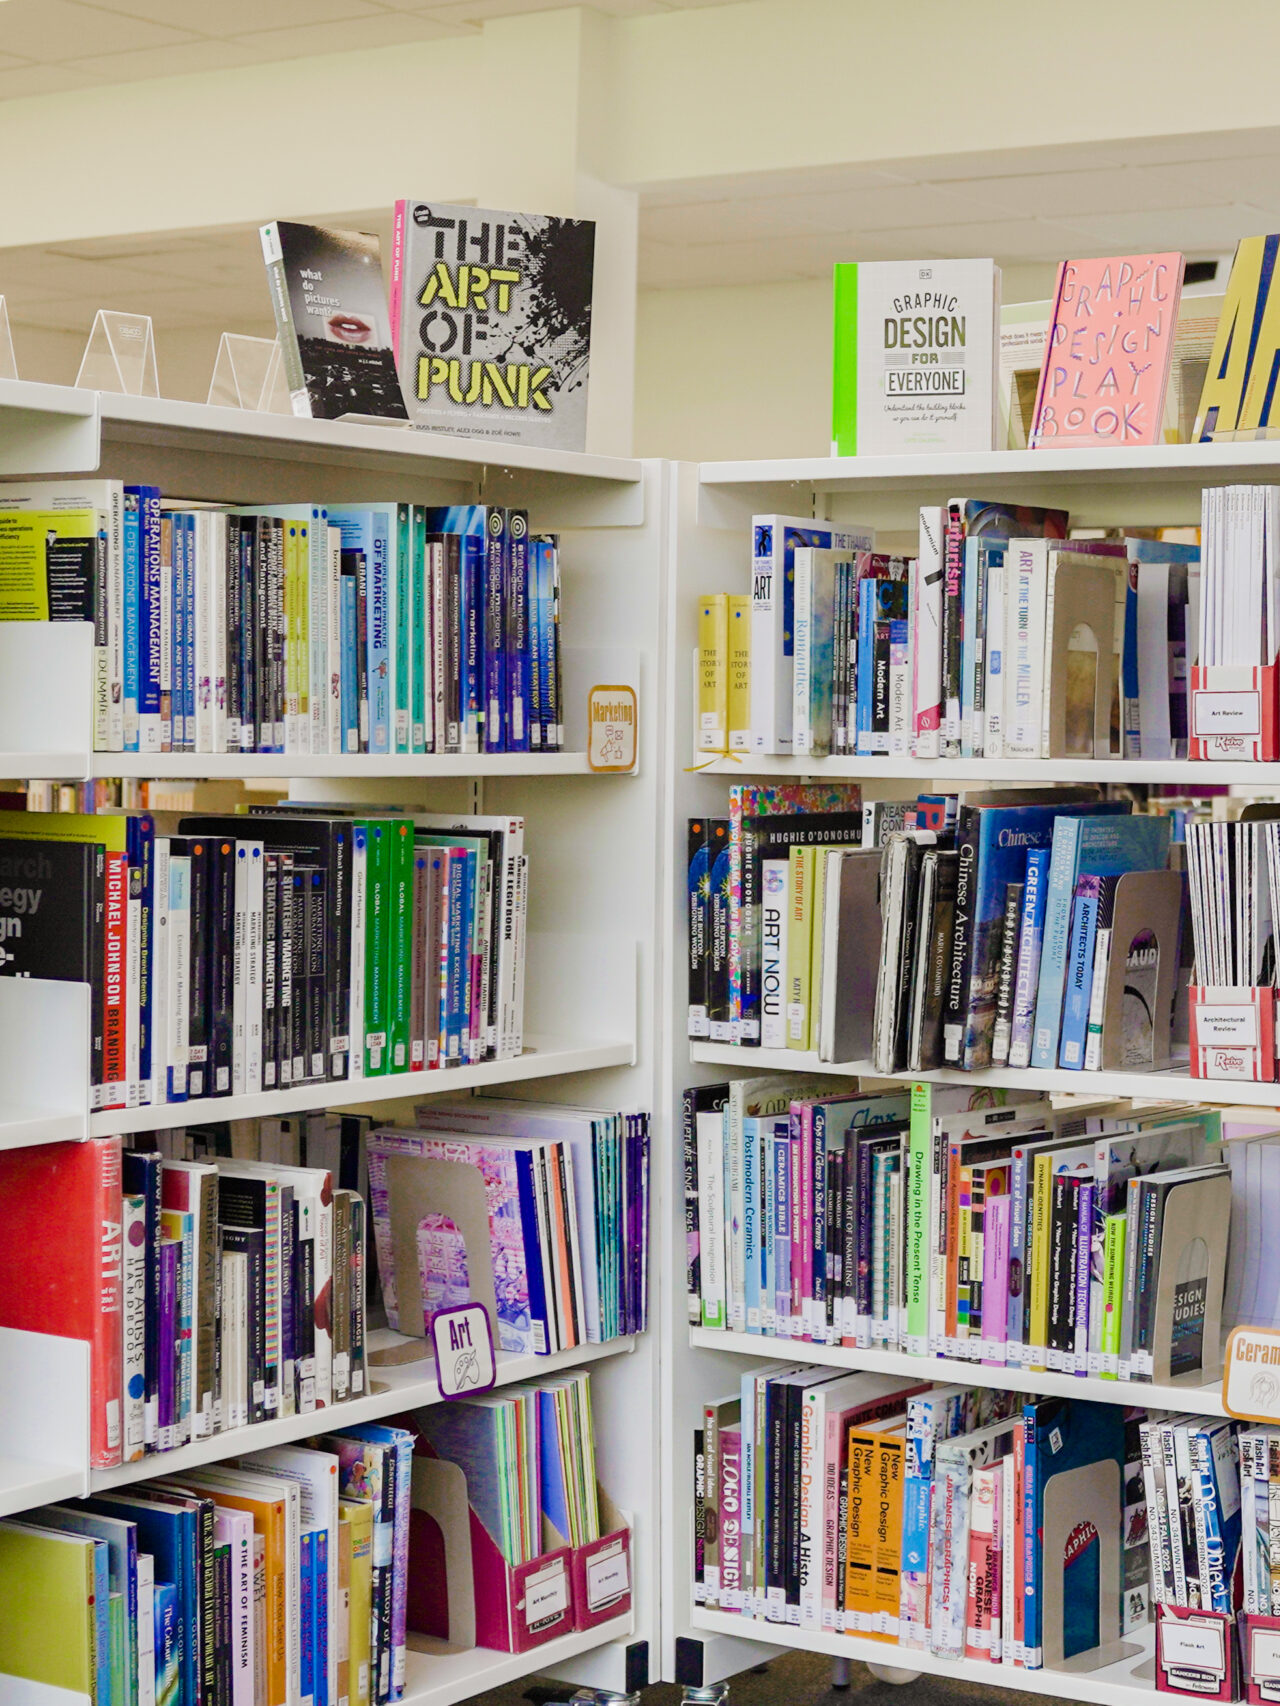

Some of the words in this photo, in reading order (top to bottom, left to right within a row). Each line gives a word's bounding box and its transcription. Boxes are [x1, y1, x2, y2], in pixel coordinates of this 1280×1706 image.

[424, 216, 522, 268] THE
[300, 269, 322, 280] what
[302, 280, 313, 290] do
[419, 263, 520, 313] ART
[1063, 260, 1167, 317] GRAPHIC
[305, 292, 340, 306] pictures
[306, 305, 332, 317] want?
[894, 292, 958, 313] GRAPHIC
[419, 310, 489, 355] OF
[884, 316, 966, 348] DESIGN
[1052, 308, 1163, 365] DESIGN
[912, 353, 939, 364] FOR
[417, 356, 552, 412] PUNK
[888, 371, 960, 391] EVERYONE
[1050, 361, 1152, 398] PLAY
[1041, 402, 1144, 441] BOOK
[150, 498, 160, 582] OPERATIONS
[374, 539, 381, 559] OF
[920, 513, 940, 556] modernism
[127, 531, 136, 603] OPERATIONS
[1020, 551, 1033, 574] ART
[1020, 575, 1028, 585] AT
[373, 562, 381, 649] MARKETING
[754, 576, 772, 600] ART
[1019, 587, 1028, 603] THE
[149, 585, 160, 685] MANAGEMENT
[469, 609, 477, 666] marketing
[1019, 606, 1028, 629] TURN
[126, 606, 136, 692] MANAGEMENT
[876, 660, 886, 699] Modern
[894, 674, 904, 713] Modern
[1016, 664, 1031, 707] MILLEN
[593, 701, 632, 725] Marketing
[876, 702, 886, 719] Art
[894, 716, 904, 732] Art
[507, 856, 515, 877] THE
[956, 843, 974, 905] Chinese
[107, 860, 122, 929] MICHAEL
[266, 877, 277, 939] STRATEGIC
[281, 876, 292, 938] STRATEGIC
[505, 880, 514, 907] LEGO
[1024, 866, 1038, 913] GREEN
[141, 907, 149, 947] Designing
[505, 909, 513, 940] BOOK
[764, 909, 780, 951] ART
[1078, 903, 1090, 959] ARCHITECTS
[106, 932, 121, 1006] JOHNSON
[266, 941, 276, 1009] MARKETING
[281, 939, 292, 1007] MARKETING
[949, 910, 969, 1010] Architecture
[1016, 917, 1034, 1024] ARCHITECTURE
[1074, 961, 1085, 990] TODAY
[140, 978, 148, 1007] Identity
[764, 960, 780, 1016] NOW
[107, 1009, 120, 1081] BRANDING
[744, 1135, 754, 1203] Postmodern
[778, 1149, 786, 1202] CERAMICS
[914, 1152, 924, 1196] Drawing
[778, 1205, 786, 1233] BIBLE
[914, 1211, 923, 1228] the
[915, 1199, 923, 1208] in
[1149, 1193, 1157, 1222] DESIGN
[745, 1207, 754, 1260] Ceramics
[845, 1223, 853, 1234] OF
[1147, 1224, 1155, 1256] STUDIES
[102, 1220, 121, 1279] ART
[845, 1237, 853, 1287] ENAMELING
[913, 1232, 923, 1272] Present
[134, 1259, 146, 1288] The
[913, 1275, 921, 1303] Tense
[127, 1259, 135, 1365] HANDBOOK
[134, 1297, 146, 1363] Artist's
[449, 1317, 472, 1351] Art
[800, 1404, 813, 1467] Graphic
[723, 1452, 739, 1513] LOGO
[851, 1447, 863, 1493] Graphic
[865, 1449, 873, 1476] New
[880, 1452, 890, 1498] Graphic
[892, 1454, 900, 1481] New
[800, 1474, 811, 1528] Design
[851, 1497, 862, 1538] Design
[944, 1474, 954, 1537] JAPANESE
[800, 1533, 811, 1546] A
[879, 1502, 889, 1542] Design
[723, 1519, 739, 1592] DESIGN
[800, 1547, 811, 1586] Histo
[942, 1540, 952, 1603] GRAPHICS
[241, 1596, 247, 1611] OF
[382, 1572, 392, 1624] History
[164, 1627, 173, 1661] Colour
[383, 1628, 391, 1642] of
